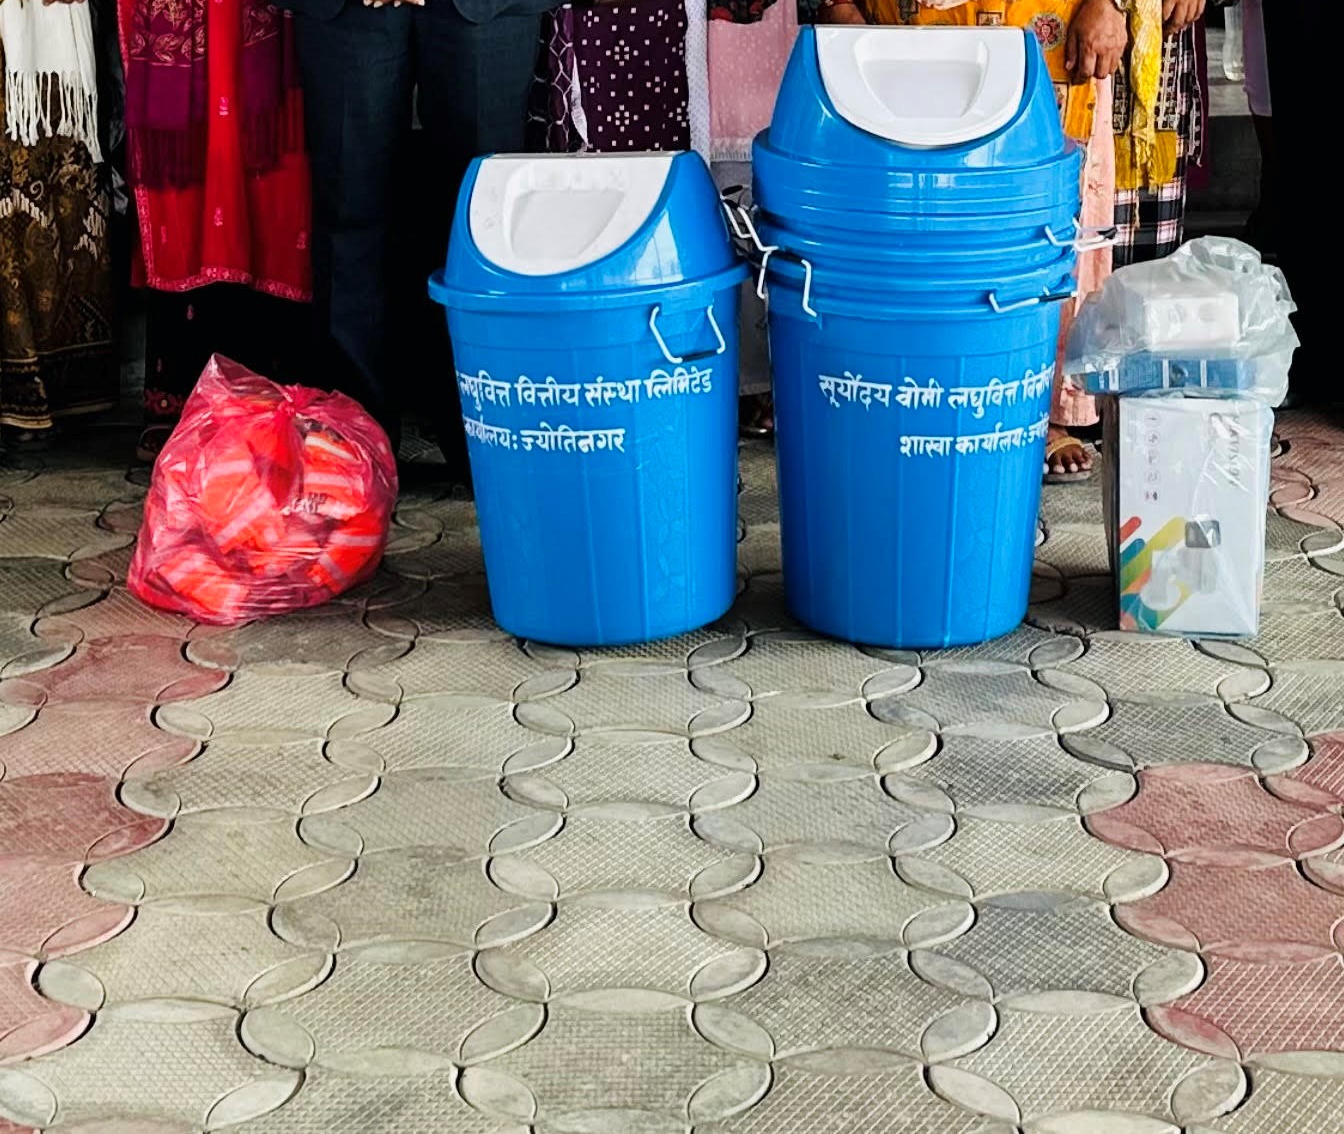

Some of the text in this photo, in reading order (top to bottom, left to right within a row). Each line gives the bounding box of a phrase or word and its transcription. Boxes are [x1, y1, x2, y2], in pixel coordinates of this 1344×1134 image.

[514, 375, 580, 408] वित्तीय
[584, 376, 641, 408] संस्था
[643, 366, 712, 400] लिमिटेड
[819, 371, 892, 411] सूर्योदय
[896, 377, 944, 409] वोमी
[948, 377, 1021, 418] लघुवित्त
[520, 422, 625, 453] ज्योतिनगर
